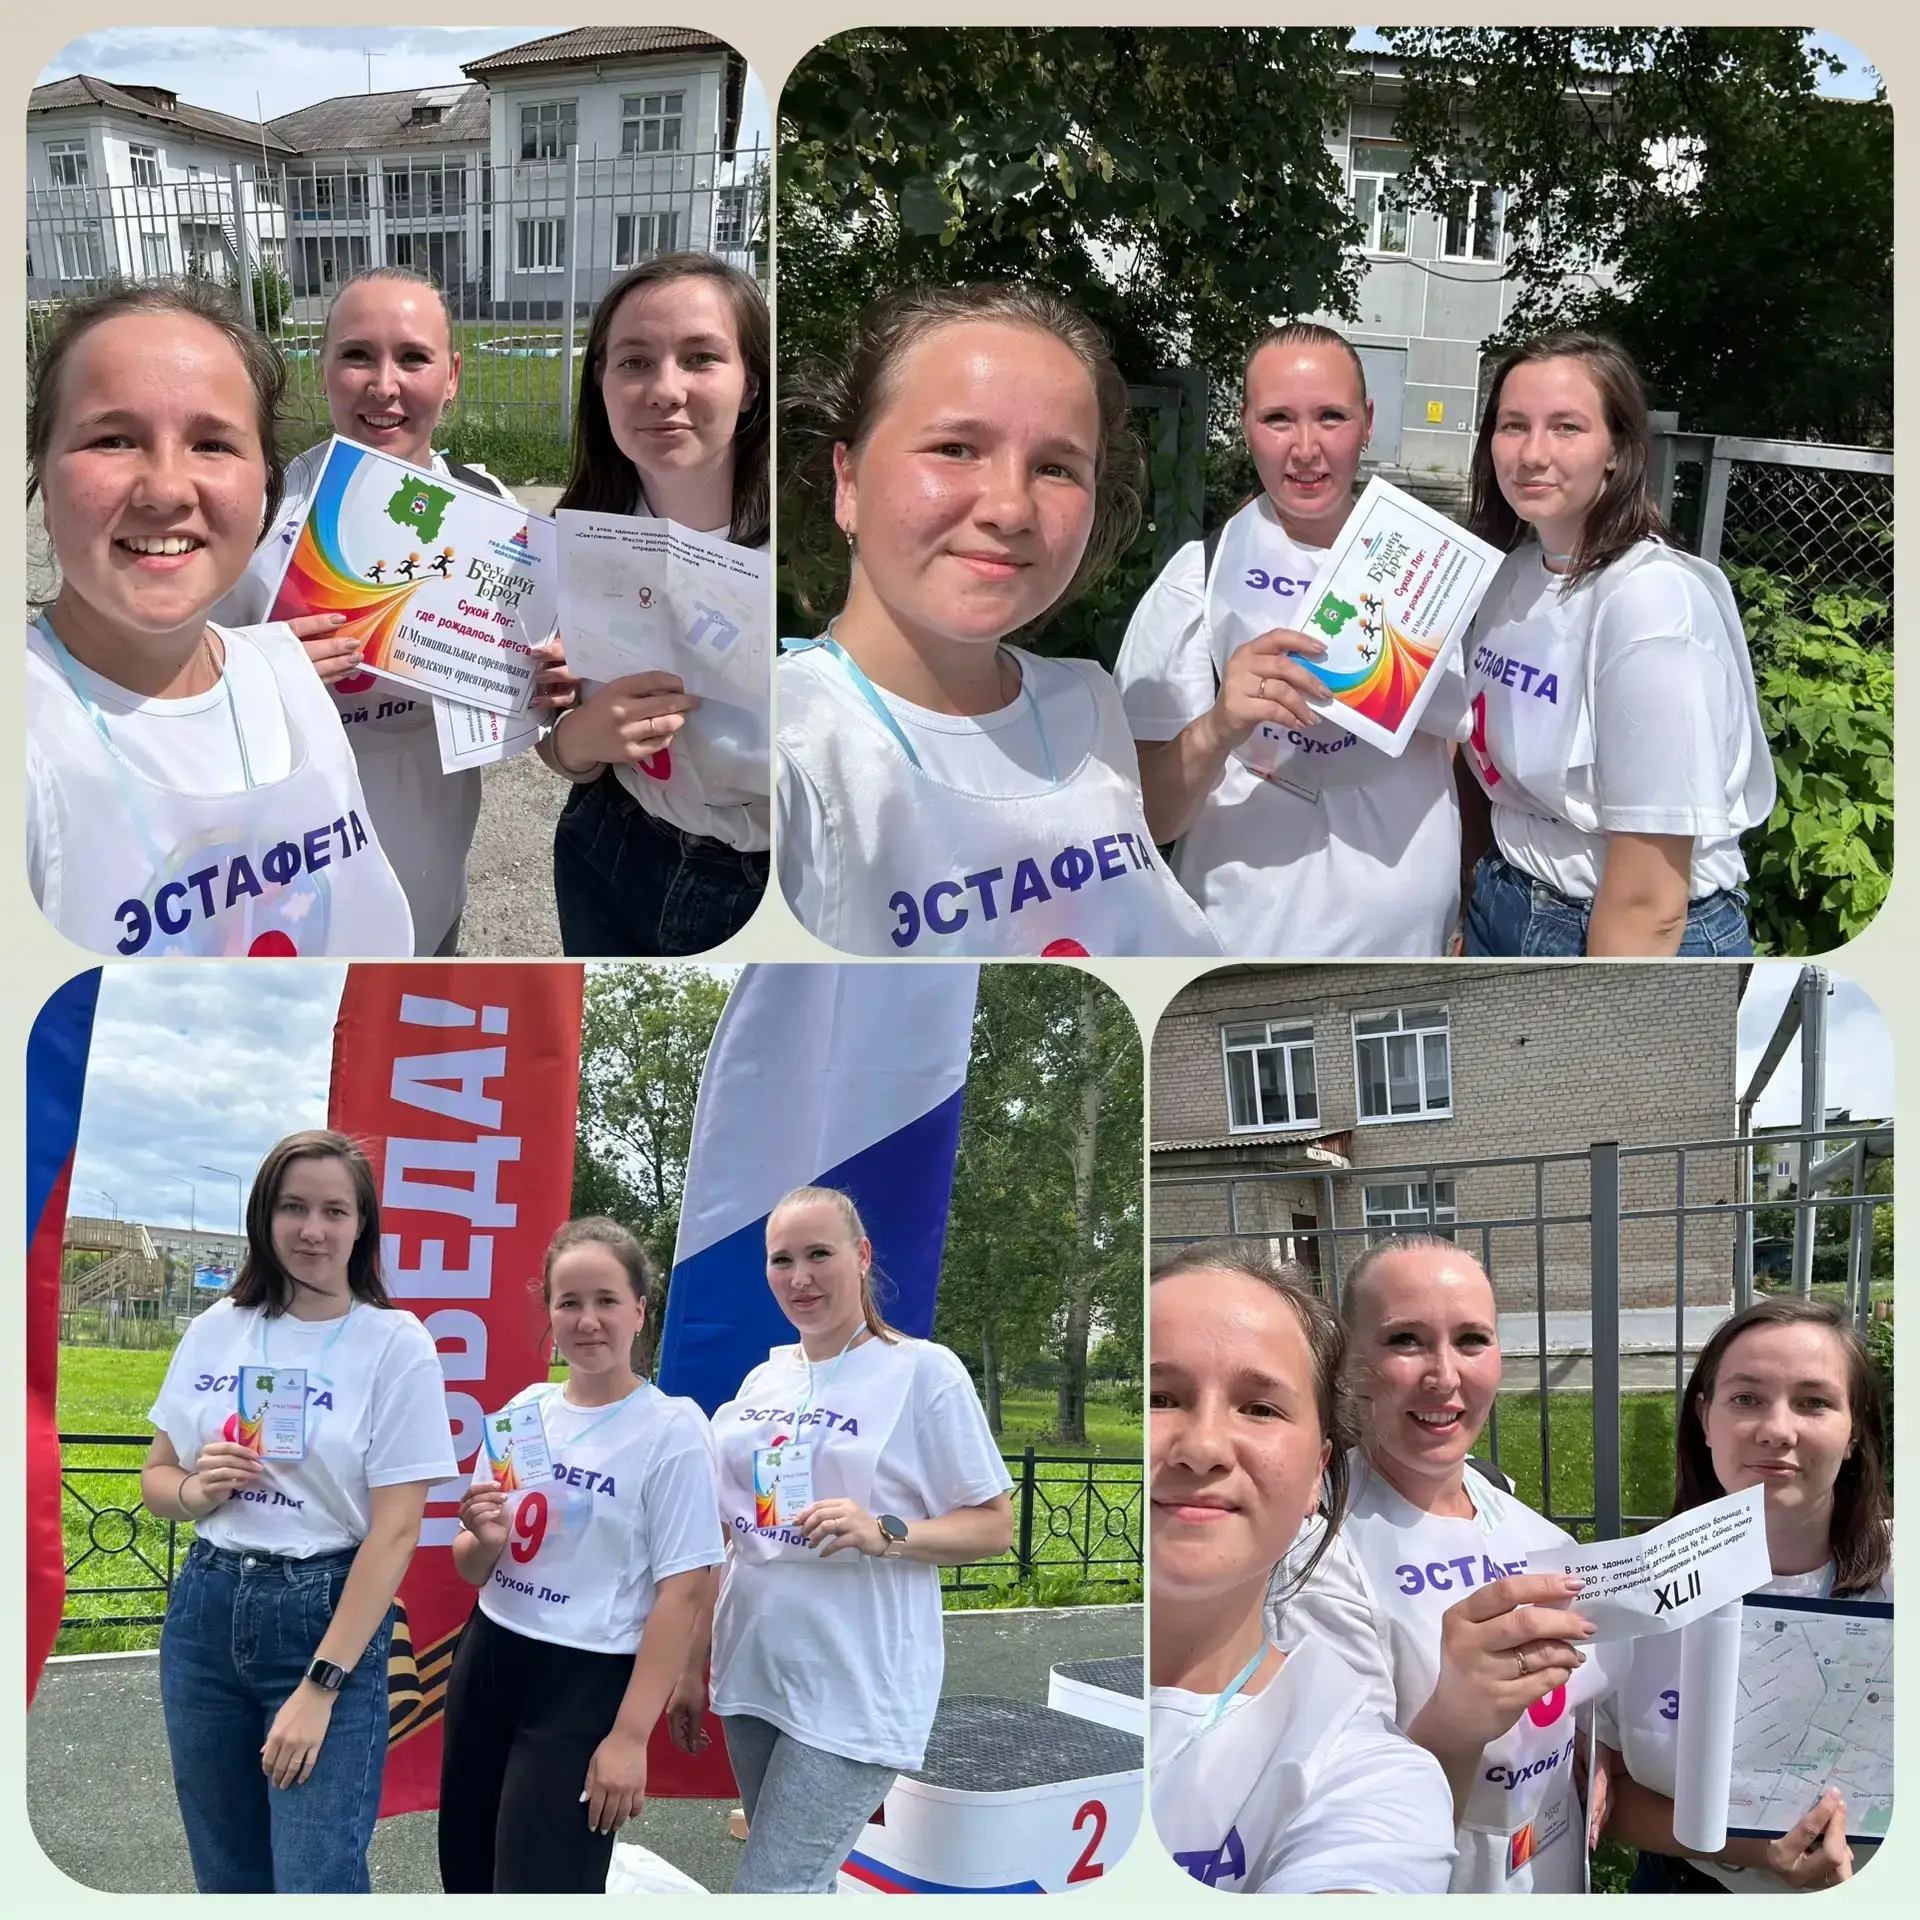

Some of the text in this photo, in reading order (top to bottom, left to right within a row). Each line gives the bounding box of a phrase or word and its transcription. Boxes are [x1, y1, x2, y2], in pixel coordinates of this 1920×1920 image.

[465, 557, 536, 596] Бегущий
[474, 577, 521, 610] Город
[1394, 549, 1427, 597] Сухой Лог:
[1400, 539, 1451, 626] где рождалось детство
[415, 609, 533, 657] где рождалось детств
[457, 599, 516, 628] Сухой Лог:
[393, 649, 521, 698] по городскому ориентированию
[406, 627, 478, 664] Муниципальные
[477, 653, 531, 680] соревнования
[1474, 645, 1559, 705] СТАФЕТА
[1262, 726, 1358, 755] г. Сухой
[114, 809, 369, 956] ЭСТАФЕТА
[888, 832, 1156, 948] ЭСТАФЕТА
[739, 1408, 859, 1436] ЭСТАФЕТА
[511, 1491, 548, 1564] 9
[778, 1529, 811, 1546] Лог
[1564, 1565, 1572, 1575] В
[1575, 1564, 1599, 1573] этом
[1602, 1556, 1634, 1570] здании
[1643, 1546, 1659, 1560] 1965
[1659, 1542, 1667, 1551] г.
[1667, 1521, 1712, 1547] располагалась
[1712, 1508, 1745, 1526] больница,
[1612, 1564, 1650, 1581] открылся
[1652, 1550, 1677, 1569] детский
[1678, 1544, 1690, 1556] сад
[1690, 1539, 1699, 1550] №
[1711, 1524, 1734, 1539] Сейчас
[1734, 1515, 1753, 1530] номер
[495, 1569, 570, 1605] Сухой Лог
[1575, 1590, 1601, 1601] этого
[1603, 1577, 1651, 1597] учреждения
[1654, 1557, 1691, 1581] зашифрован
[1697, 1541, 1722, 1557] Римских
[1723, 1529, 1748, 1548] цифрах:
[1654, 1570, 1701, 1615] XLII
[1486, 1749, 1560, 1790] Сухой
[1067, 1800, 1108, 1884] 2
